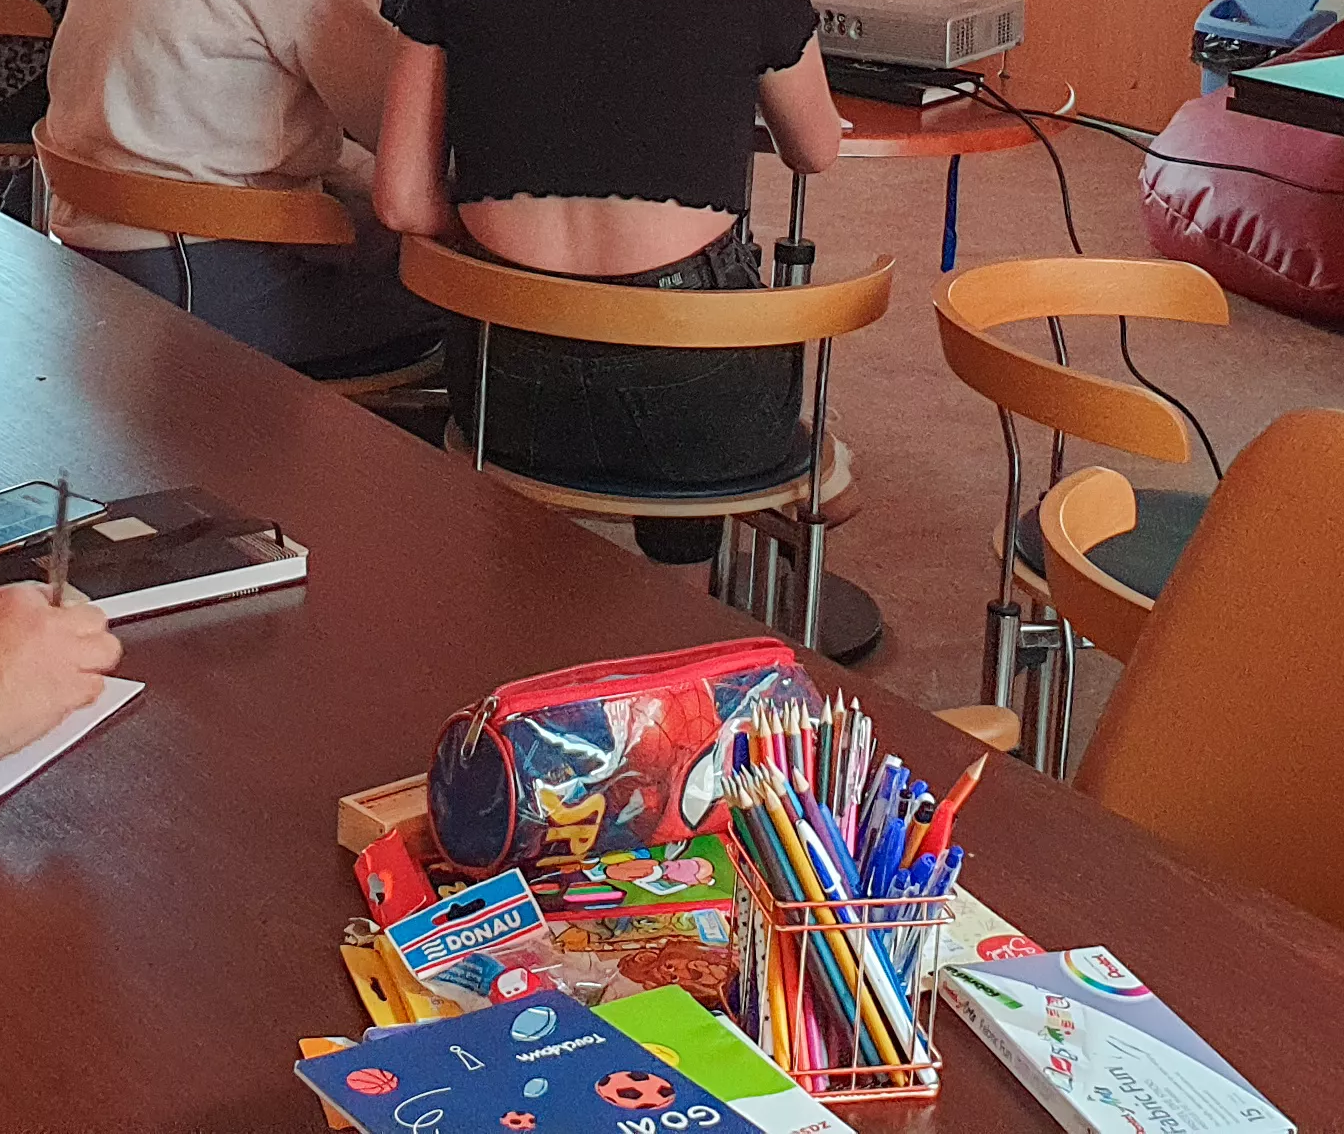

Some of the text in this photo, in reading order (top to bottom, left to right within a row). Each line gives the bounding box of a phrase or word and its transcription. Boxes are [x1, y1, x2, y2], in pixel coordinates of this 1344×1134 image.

[445, 909, 522, 951] DONAU
[515, 1033, 606, 1062] Touchdown
[1108, 1066, 1144, 1094] Fun
[1134, 1094, 1187, 1134] Fabric
[1240, 1107, 1266, 1122] 15
